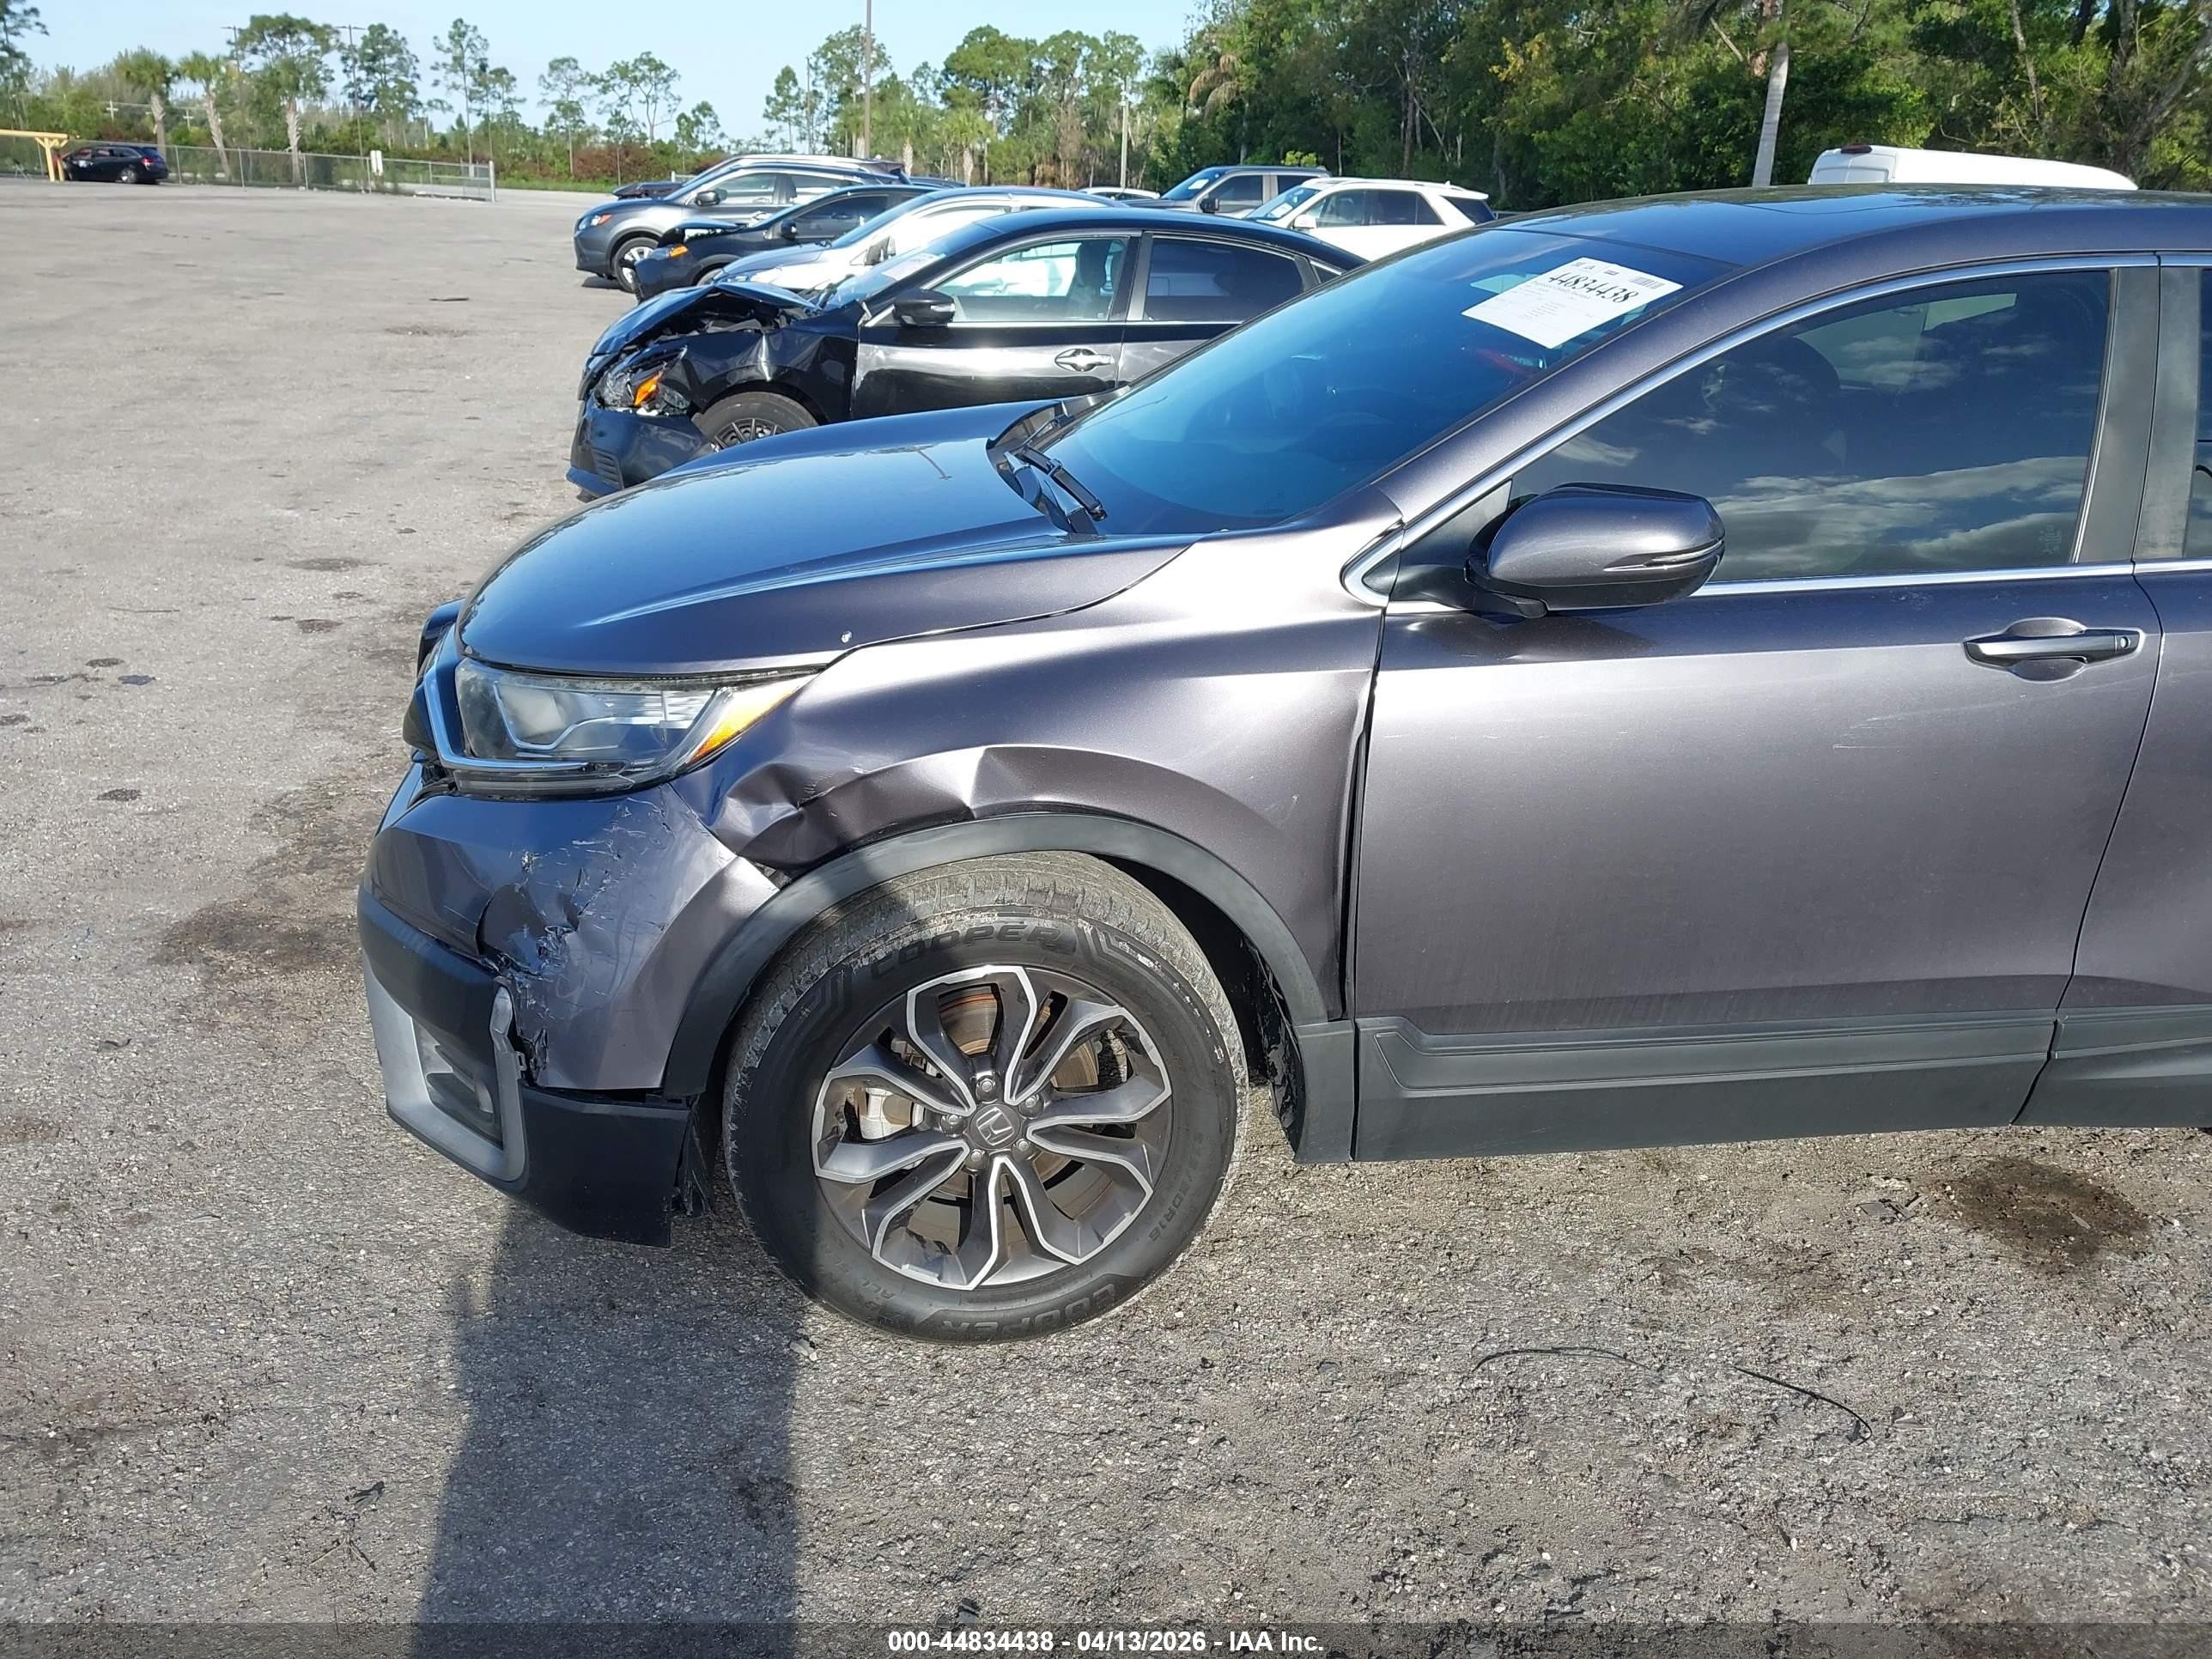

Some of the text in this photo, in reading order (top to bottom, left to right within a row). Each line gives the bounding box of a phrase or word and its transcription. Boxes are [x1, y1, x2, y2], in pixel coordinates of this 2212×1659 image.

[1548, 271, 1640, 304] 44834438
[870, 923, 1062, 976] COOPER
[940, 1283, 1115, 1342] COOPER
